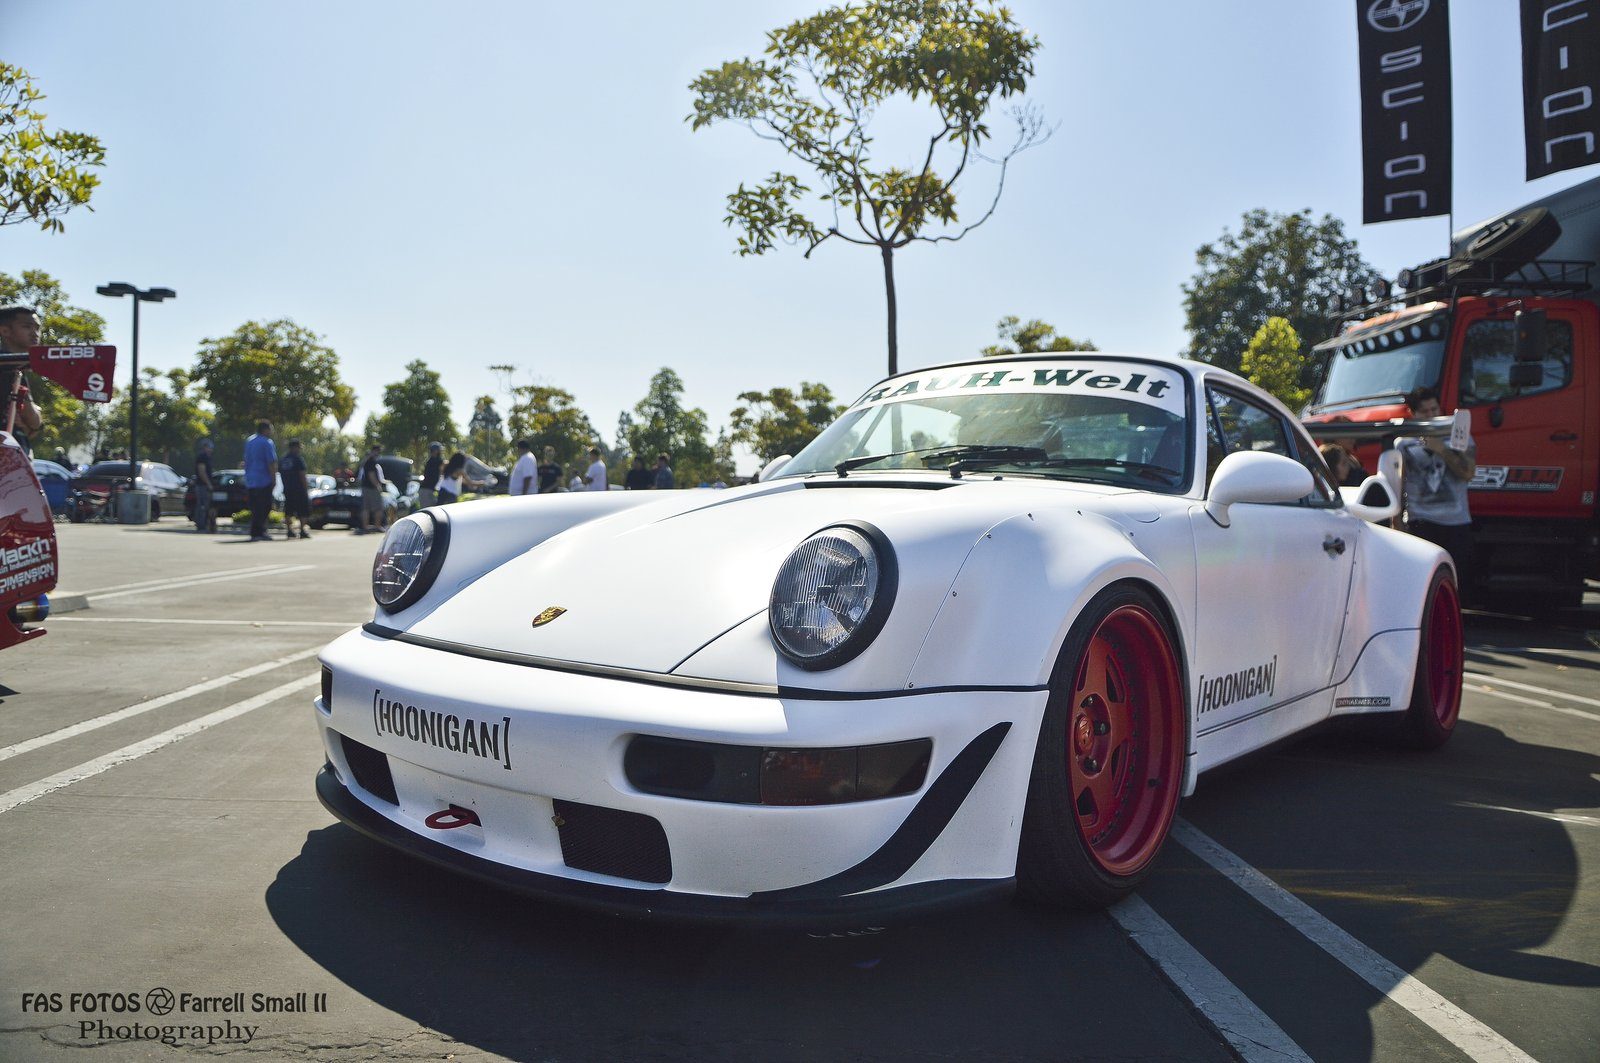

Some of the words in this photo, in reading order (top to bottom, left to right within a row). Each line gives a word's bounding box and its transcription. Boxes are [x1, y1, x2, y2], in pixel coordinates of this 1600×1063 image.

[47, 347, 95, 359] COBB
[858, 368, 1170, 404] RAUH-Welt
[373, 689, 512, 770] [HOONIGAN]
